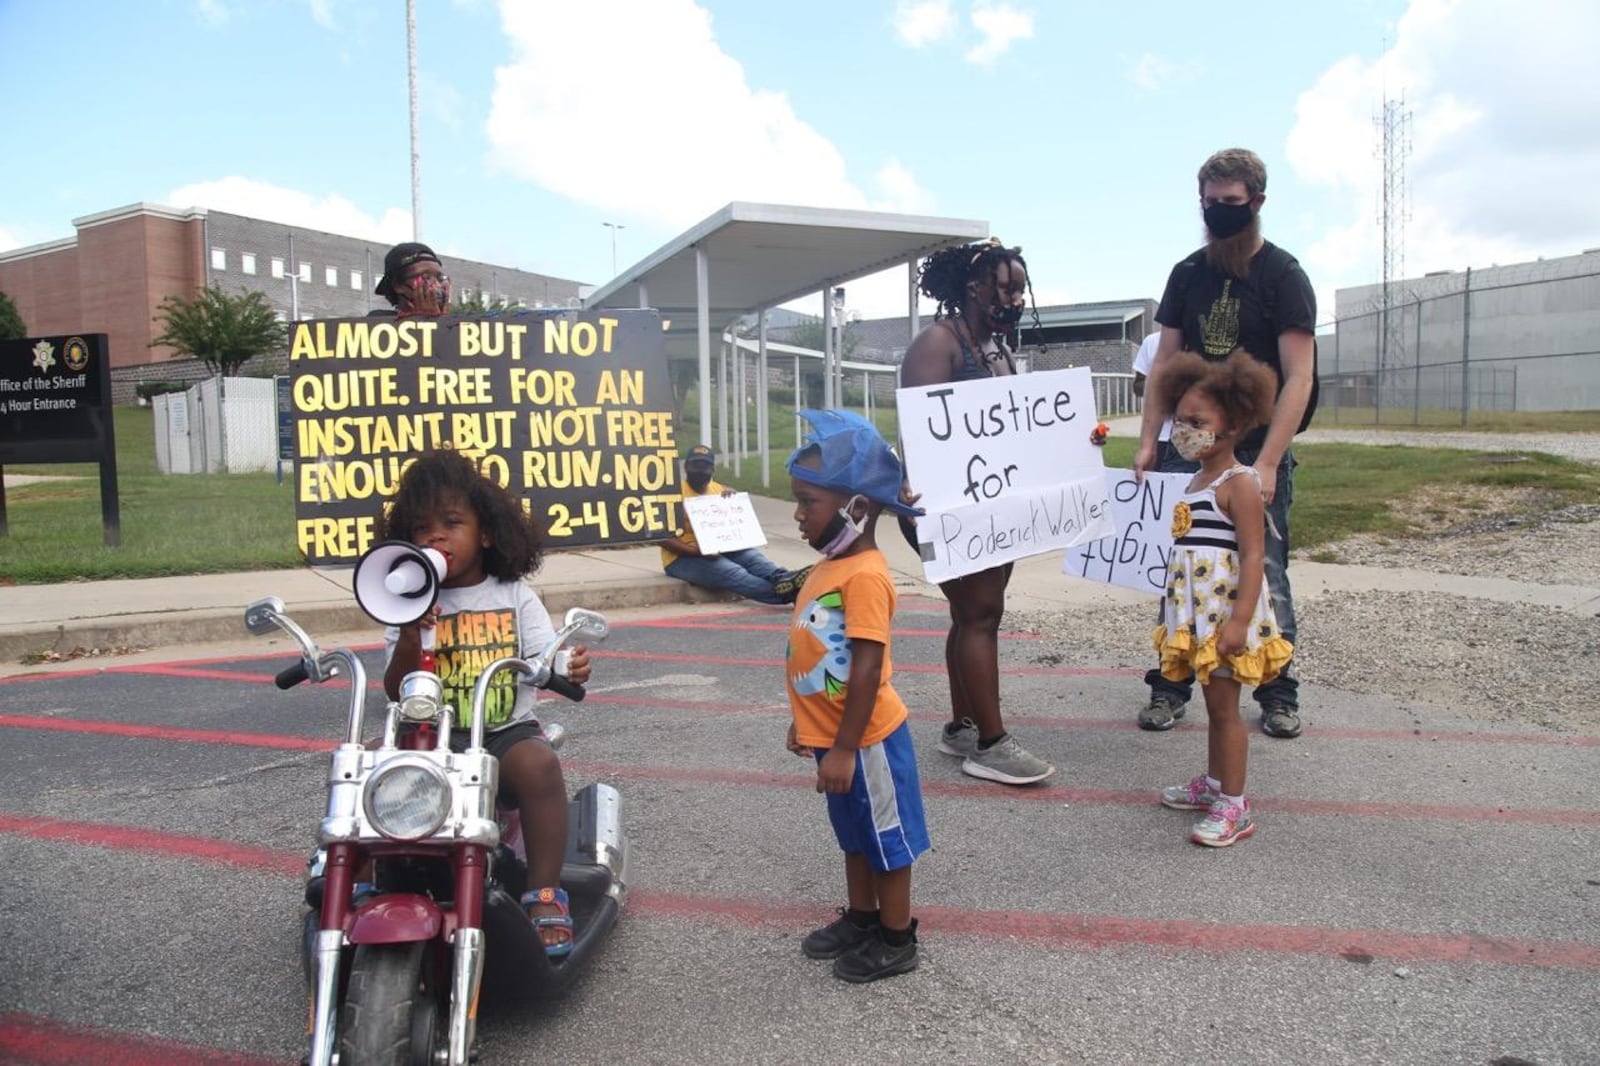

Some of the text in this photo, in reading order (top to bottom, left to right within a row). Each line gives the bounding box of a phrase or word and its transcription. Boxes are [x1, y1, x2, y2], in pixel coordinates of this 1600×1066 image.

[291, 318, 618, 360] ALMOST BUT NOT
[0, 374, 86, 391] ffice of the Sheriff
[293, 366, 644, 412] QUITE. FREE FOR AN
[0, 398, 76, 415] 4 Hour Entrance
[452, 411, 516, 449] BUT
[530, 406, 602, 448] NOT
[606, 411, 675, 447] FREE
[927, 388, 1076, 441] Justice
[300, 457, 418, 502] ENOU
[459, 449, 510, 490] TO
[615, 449, 679, 491] NOT
[963, 454, 1018, 502] for
[1041, 483, 1109, 537] Walker
[1114, 479, 1164, 520] No
[297, 516, 375, 558] FREE
[548, 501, 610, 539] 2-4
[618, 494, 684, 537] GET.
[1080, 521, 1172, 589] Right
[436, 612, 515, 649] M HERE
[458, 686, 514, 728] WRLD
